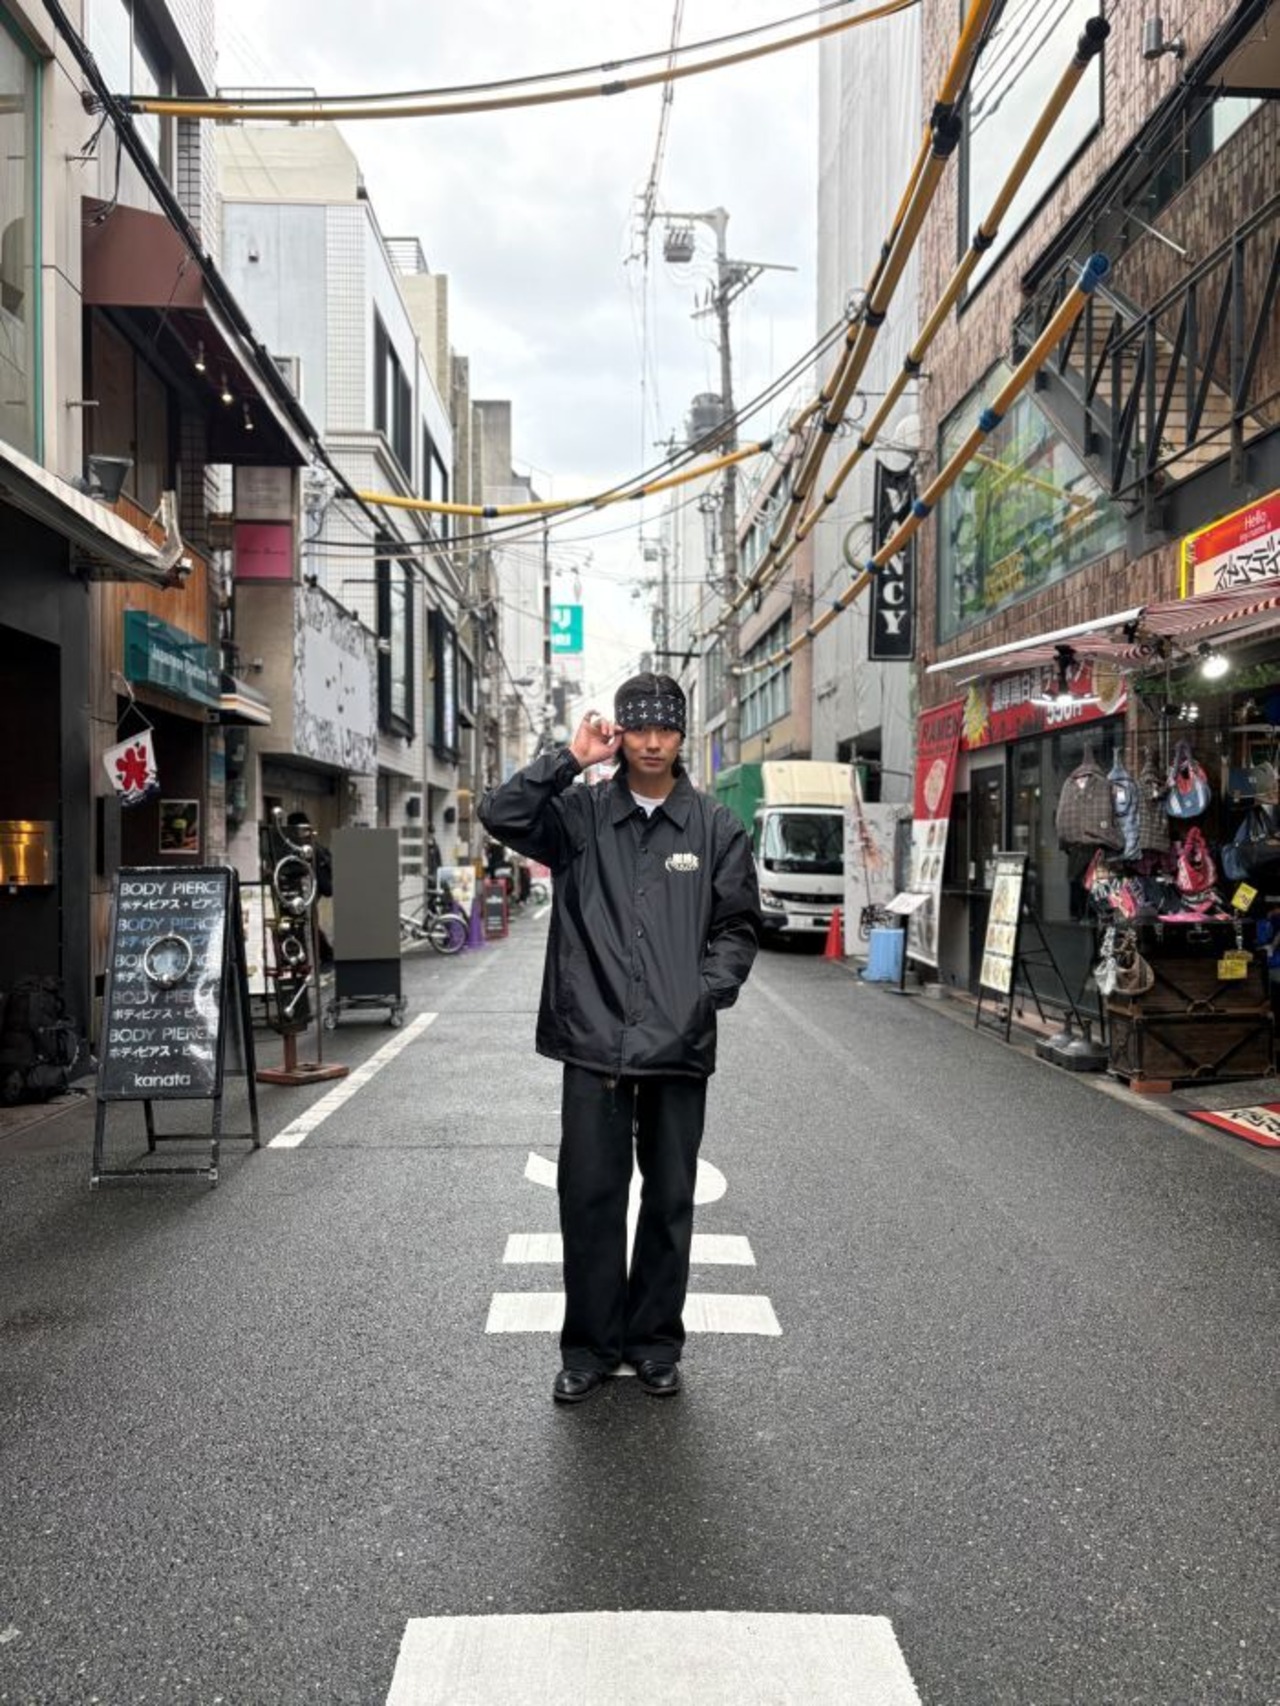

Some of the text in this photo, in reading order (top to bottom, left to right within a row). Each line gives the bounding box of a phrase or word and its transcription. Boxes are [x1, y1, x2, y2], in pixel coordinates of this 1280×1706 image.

[120, 882, 166, 896] BODY
[118, 917, 221, 932] BODY PIERC
[112, 990, 159, 1005] BODY
[110, 1028, 156, 1043] BODY
[135, 1072, 191, 1087] kanata
